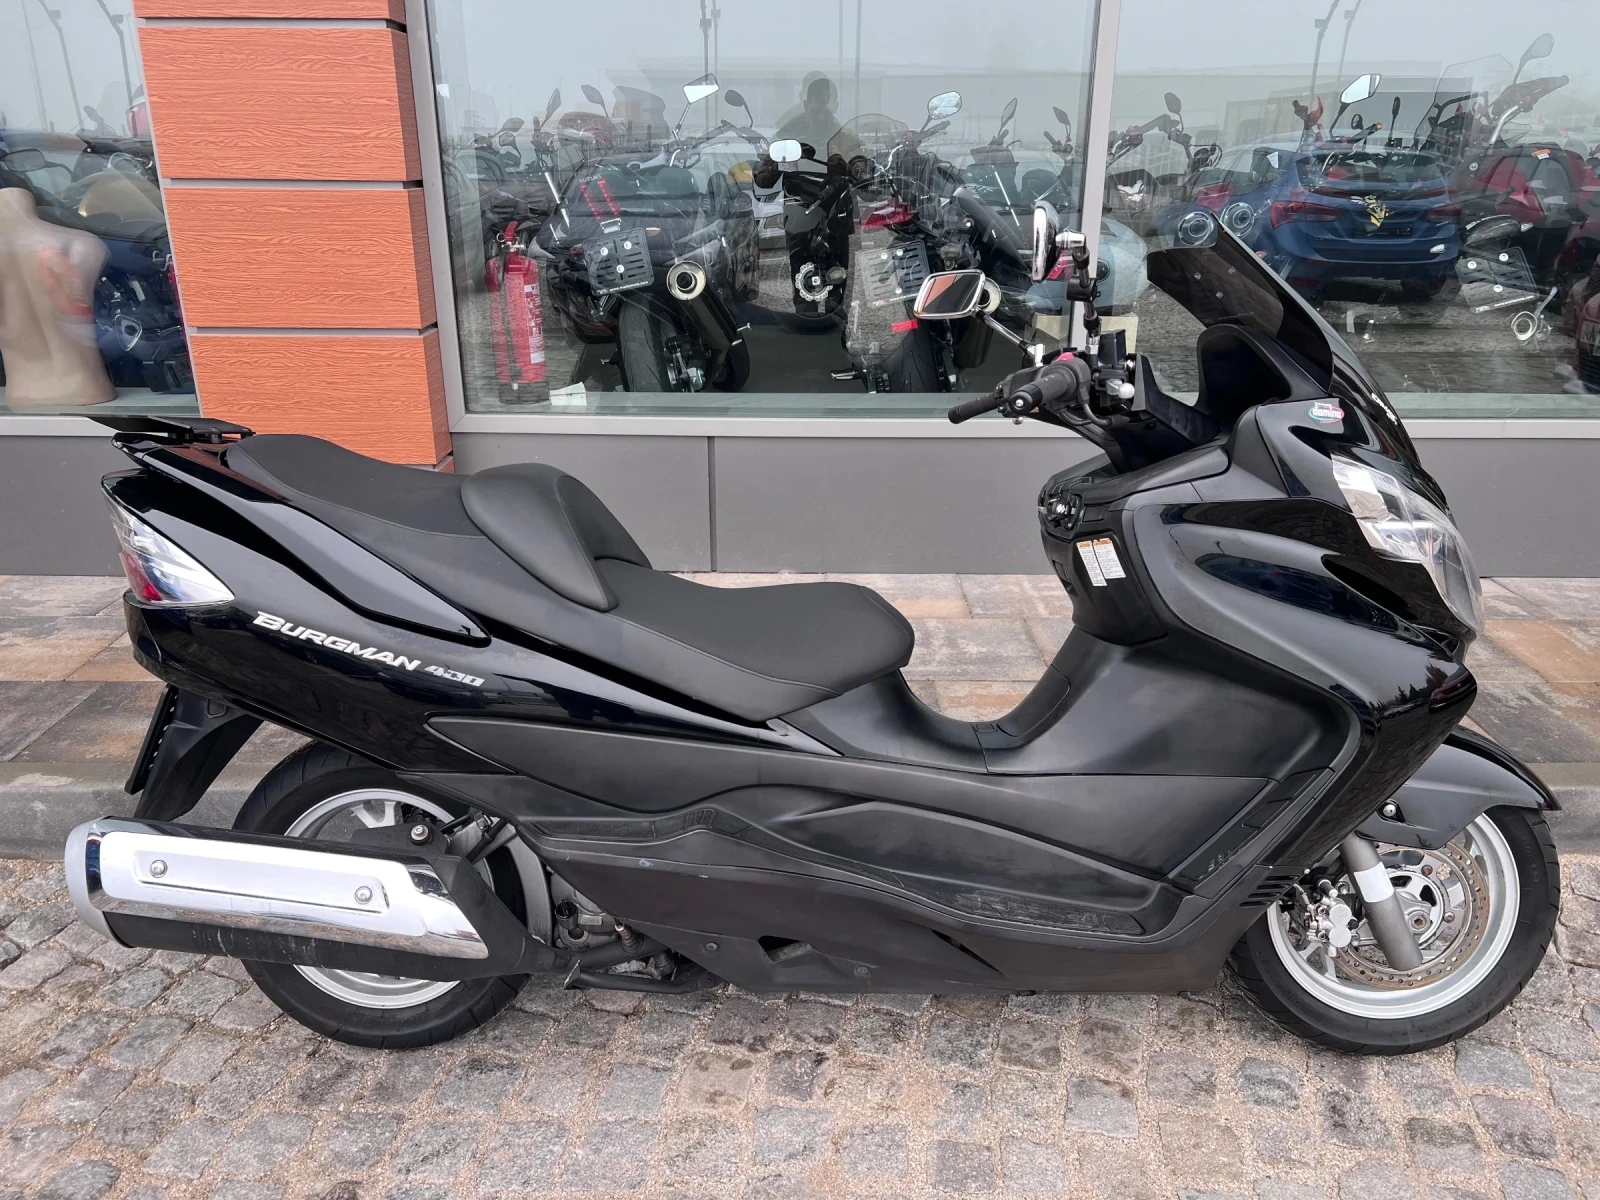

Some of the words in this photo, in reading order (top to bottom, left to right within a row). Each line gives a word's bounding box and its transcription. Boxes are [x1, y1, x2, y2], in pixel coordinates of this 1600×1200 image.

[1312, 401, 1342, 419] domino
[252, 610, 422, 671] BURGMAN
[424, 665, 485, 687] 400
